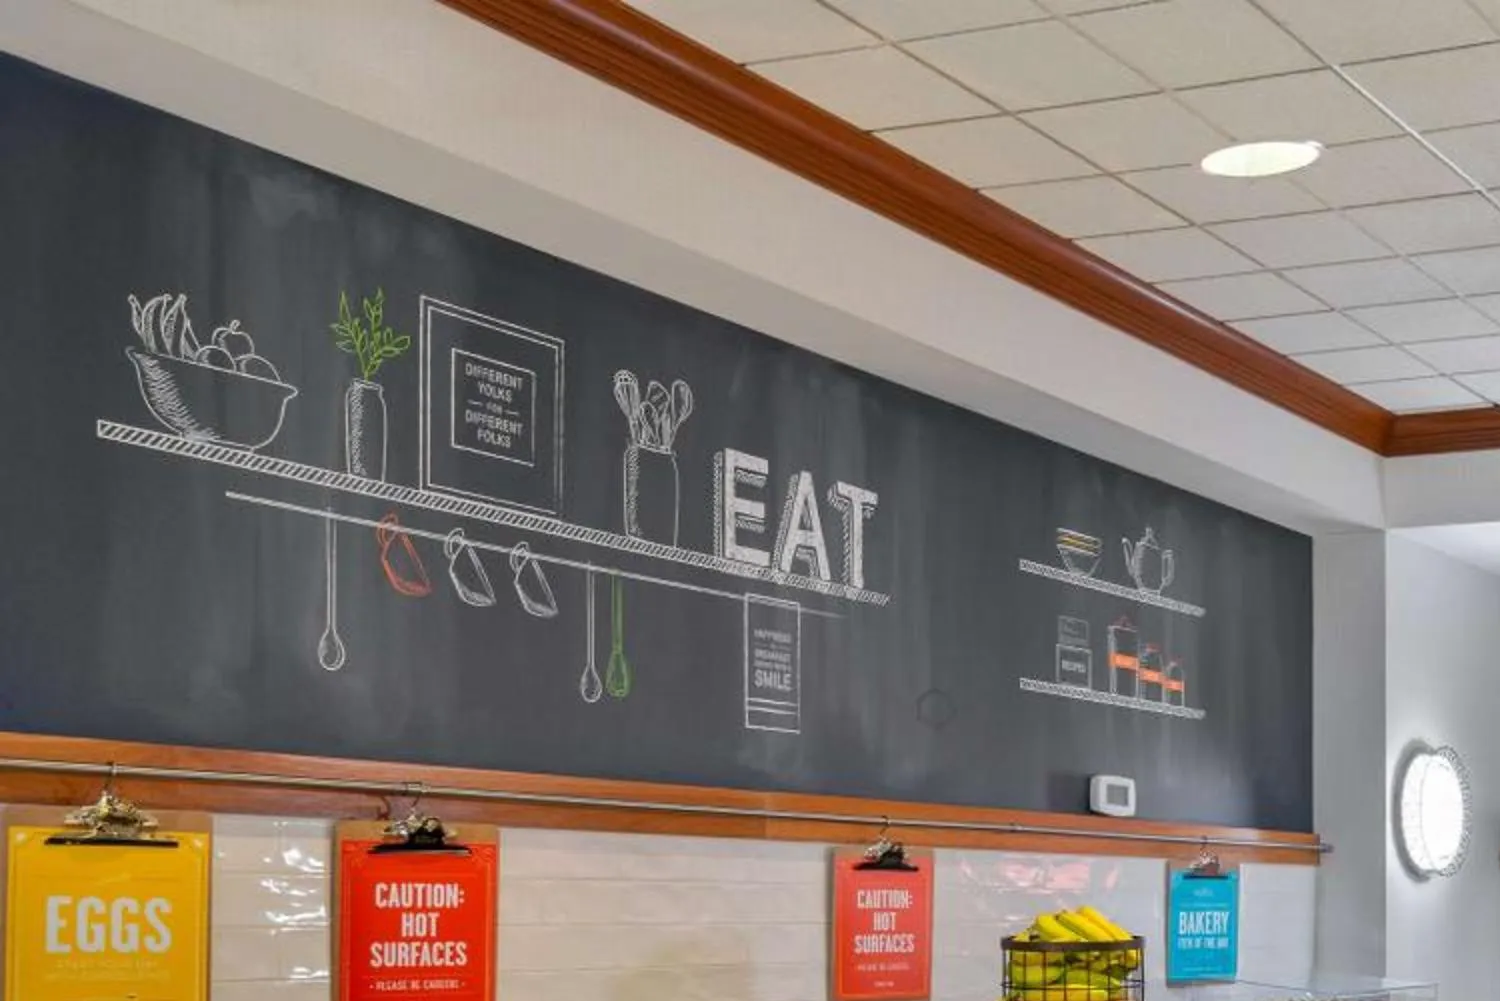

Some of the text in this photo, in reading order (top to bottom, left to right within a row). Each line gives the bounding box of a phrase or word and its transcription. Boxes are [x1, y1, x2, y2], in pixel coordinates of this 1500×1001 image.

[465, 362, 523, 391] DIFFERENT
[478, 381, 513, 404] YOLKS
[465, 409, 523, 438] DIFFERENT
[477, 427, 512, 449] FOLKS
[713, 447, 878, 590] EAT
[754, 669, 793, 692] SMILE
[374, 882, 466, 909] CAUTION:
[857, 888, 914, 909] CAUTION:
[46, 895, 173, 953] EGGS
[401, 911, 440, 938] HOT
[873, 911, 897, 931] HOT
[1178, 911, 1230, 935] BAKERY
[369, 941, 468, 968] SURFACES
[854, 933, 915, 954] SURFACES
